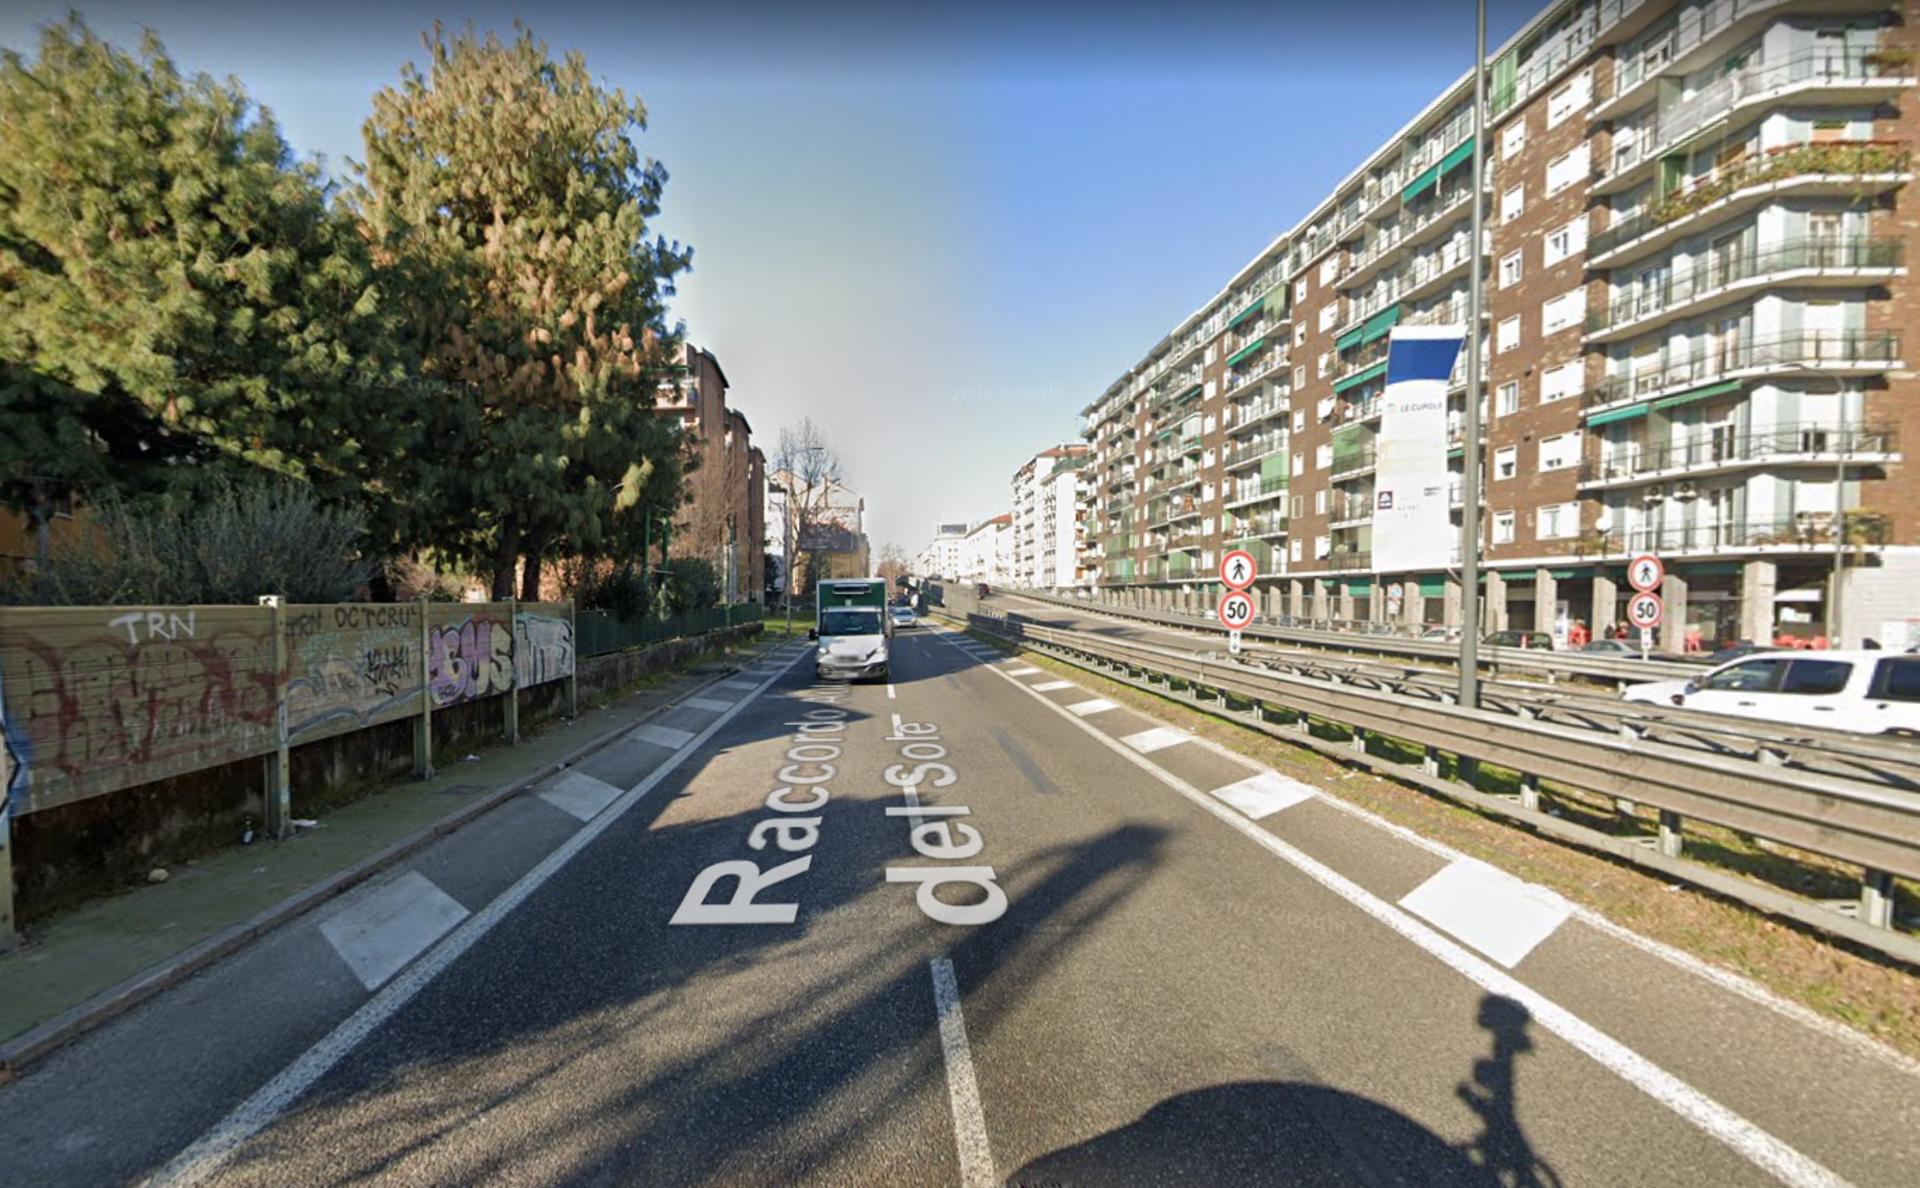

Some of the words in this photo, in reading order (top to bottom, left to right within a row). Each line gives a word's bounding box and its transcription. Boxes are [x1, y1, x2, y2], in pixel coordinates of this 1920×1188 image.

[1226, 601, 1247, 619] 50
[1636, 601, 1656, 618] 50
[108, 611, 195, 644] TRN
